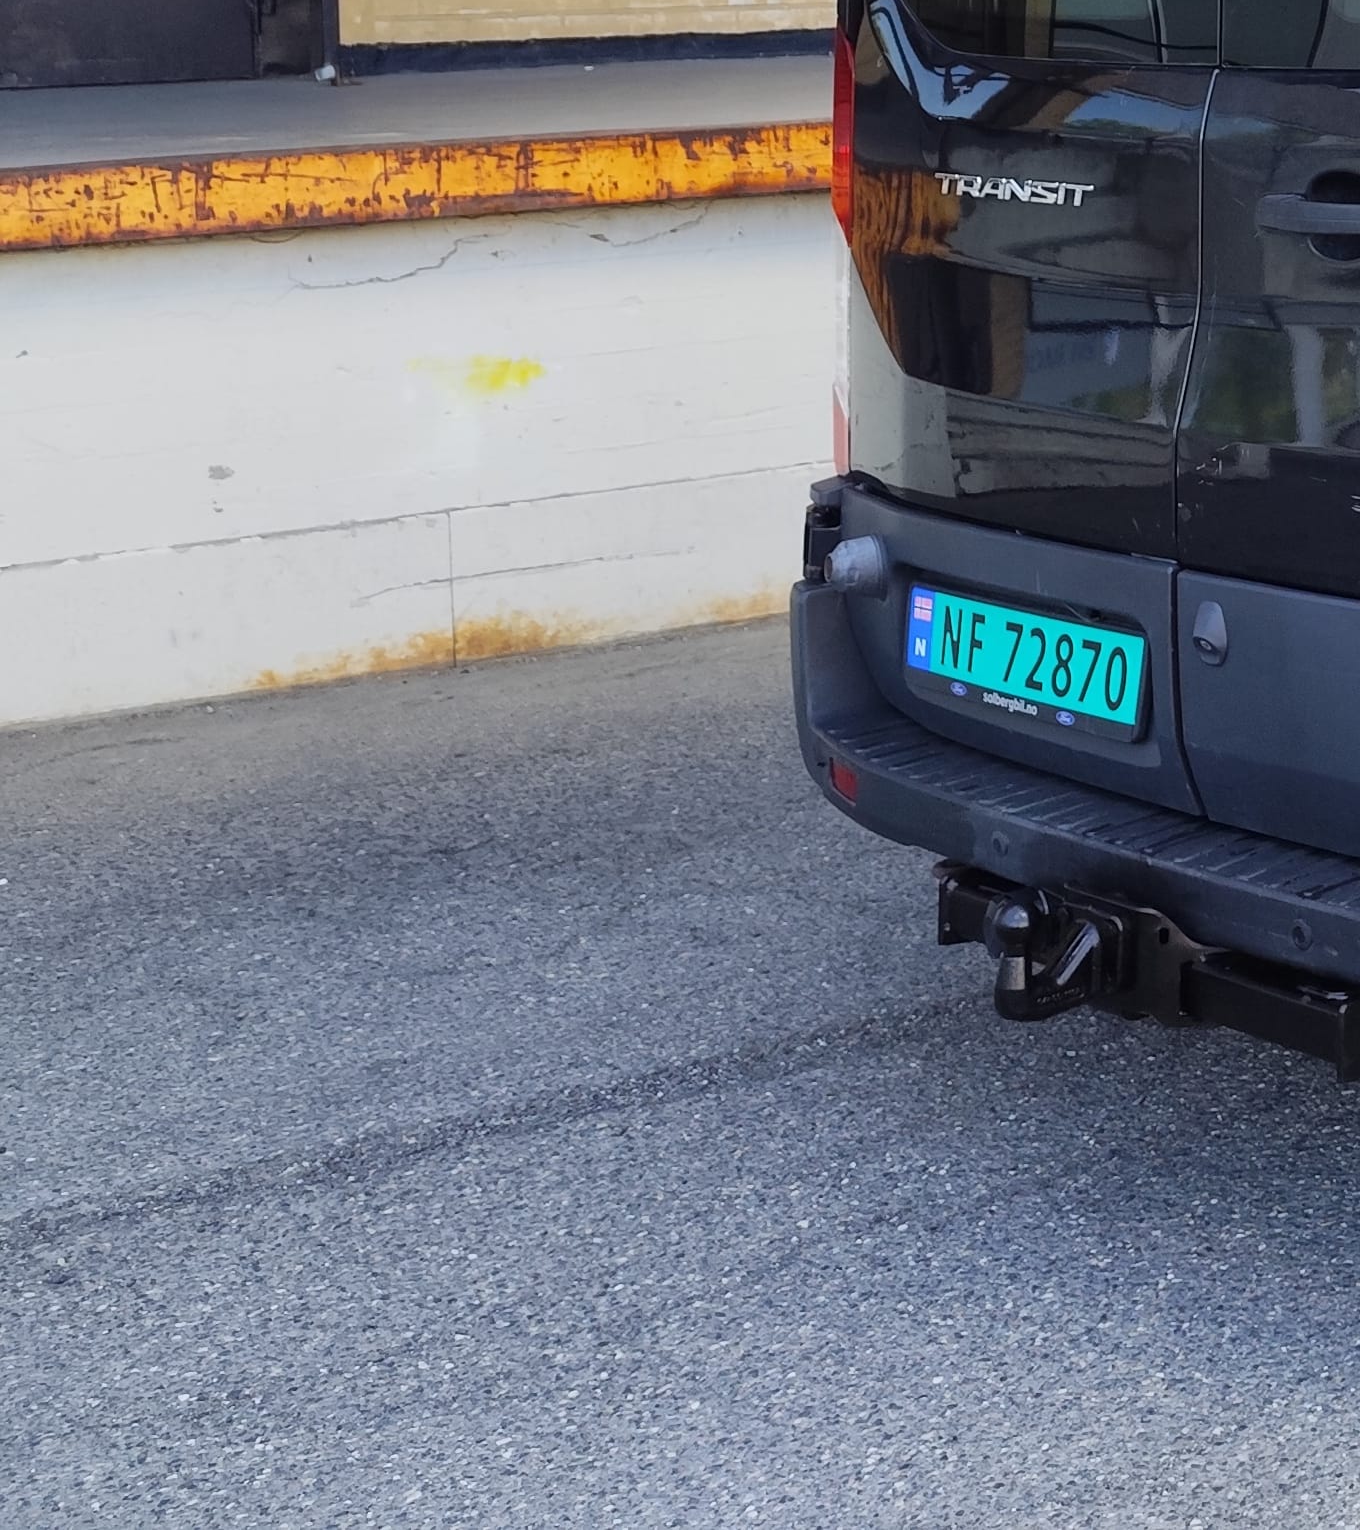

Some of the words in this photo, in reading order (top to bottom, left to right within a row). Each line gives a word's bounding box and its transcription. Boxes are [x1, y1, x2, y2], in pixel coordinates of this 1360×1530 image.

[934, 172, 1095, 207] TRANSIT
[914, 636, 928, 658] N
[940, 604, 986, 674] NF
[1002, 620, 1129, 712] 72870
[982, 691, 1038, 717] solbergbil.no
